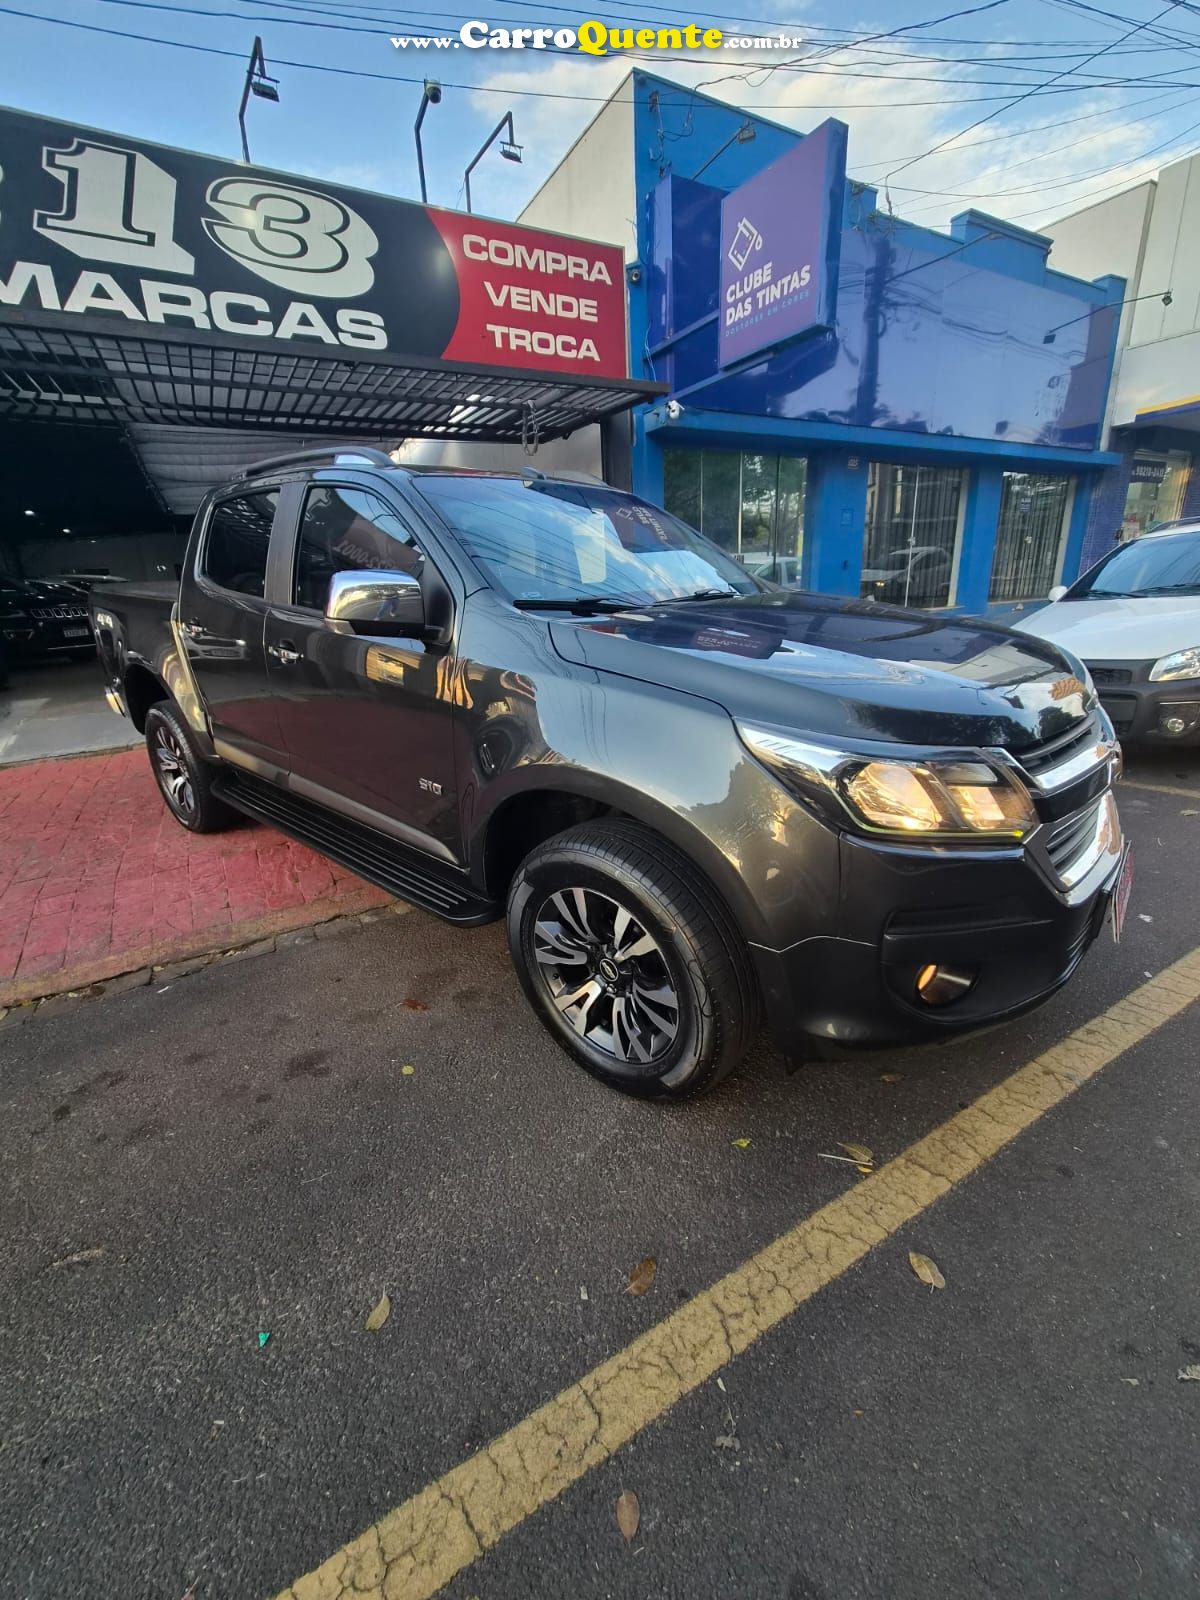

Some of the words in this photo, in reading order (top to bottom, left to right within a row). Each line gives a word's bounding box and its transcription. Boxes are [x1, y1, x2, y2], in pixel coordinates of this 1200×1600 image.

[462, 233, 613, 286] COMPRA
[483, 280, 599, 323] VENDE
[725, 297, 753, 326] DAS
[756, 265, 811, 308] TINTAS
[726, 262, 773, 303] CLUBE
[486, 323, 601, 362] TROCA
[418, 777, 442, 796] S10
